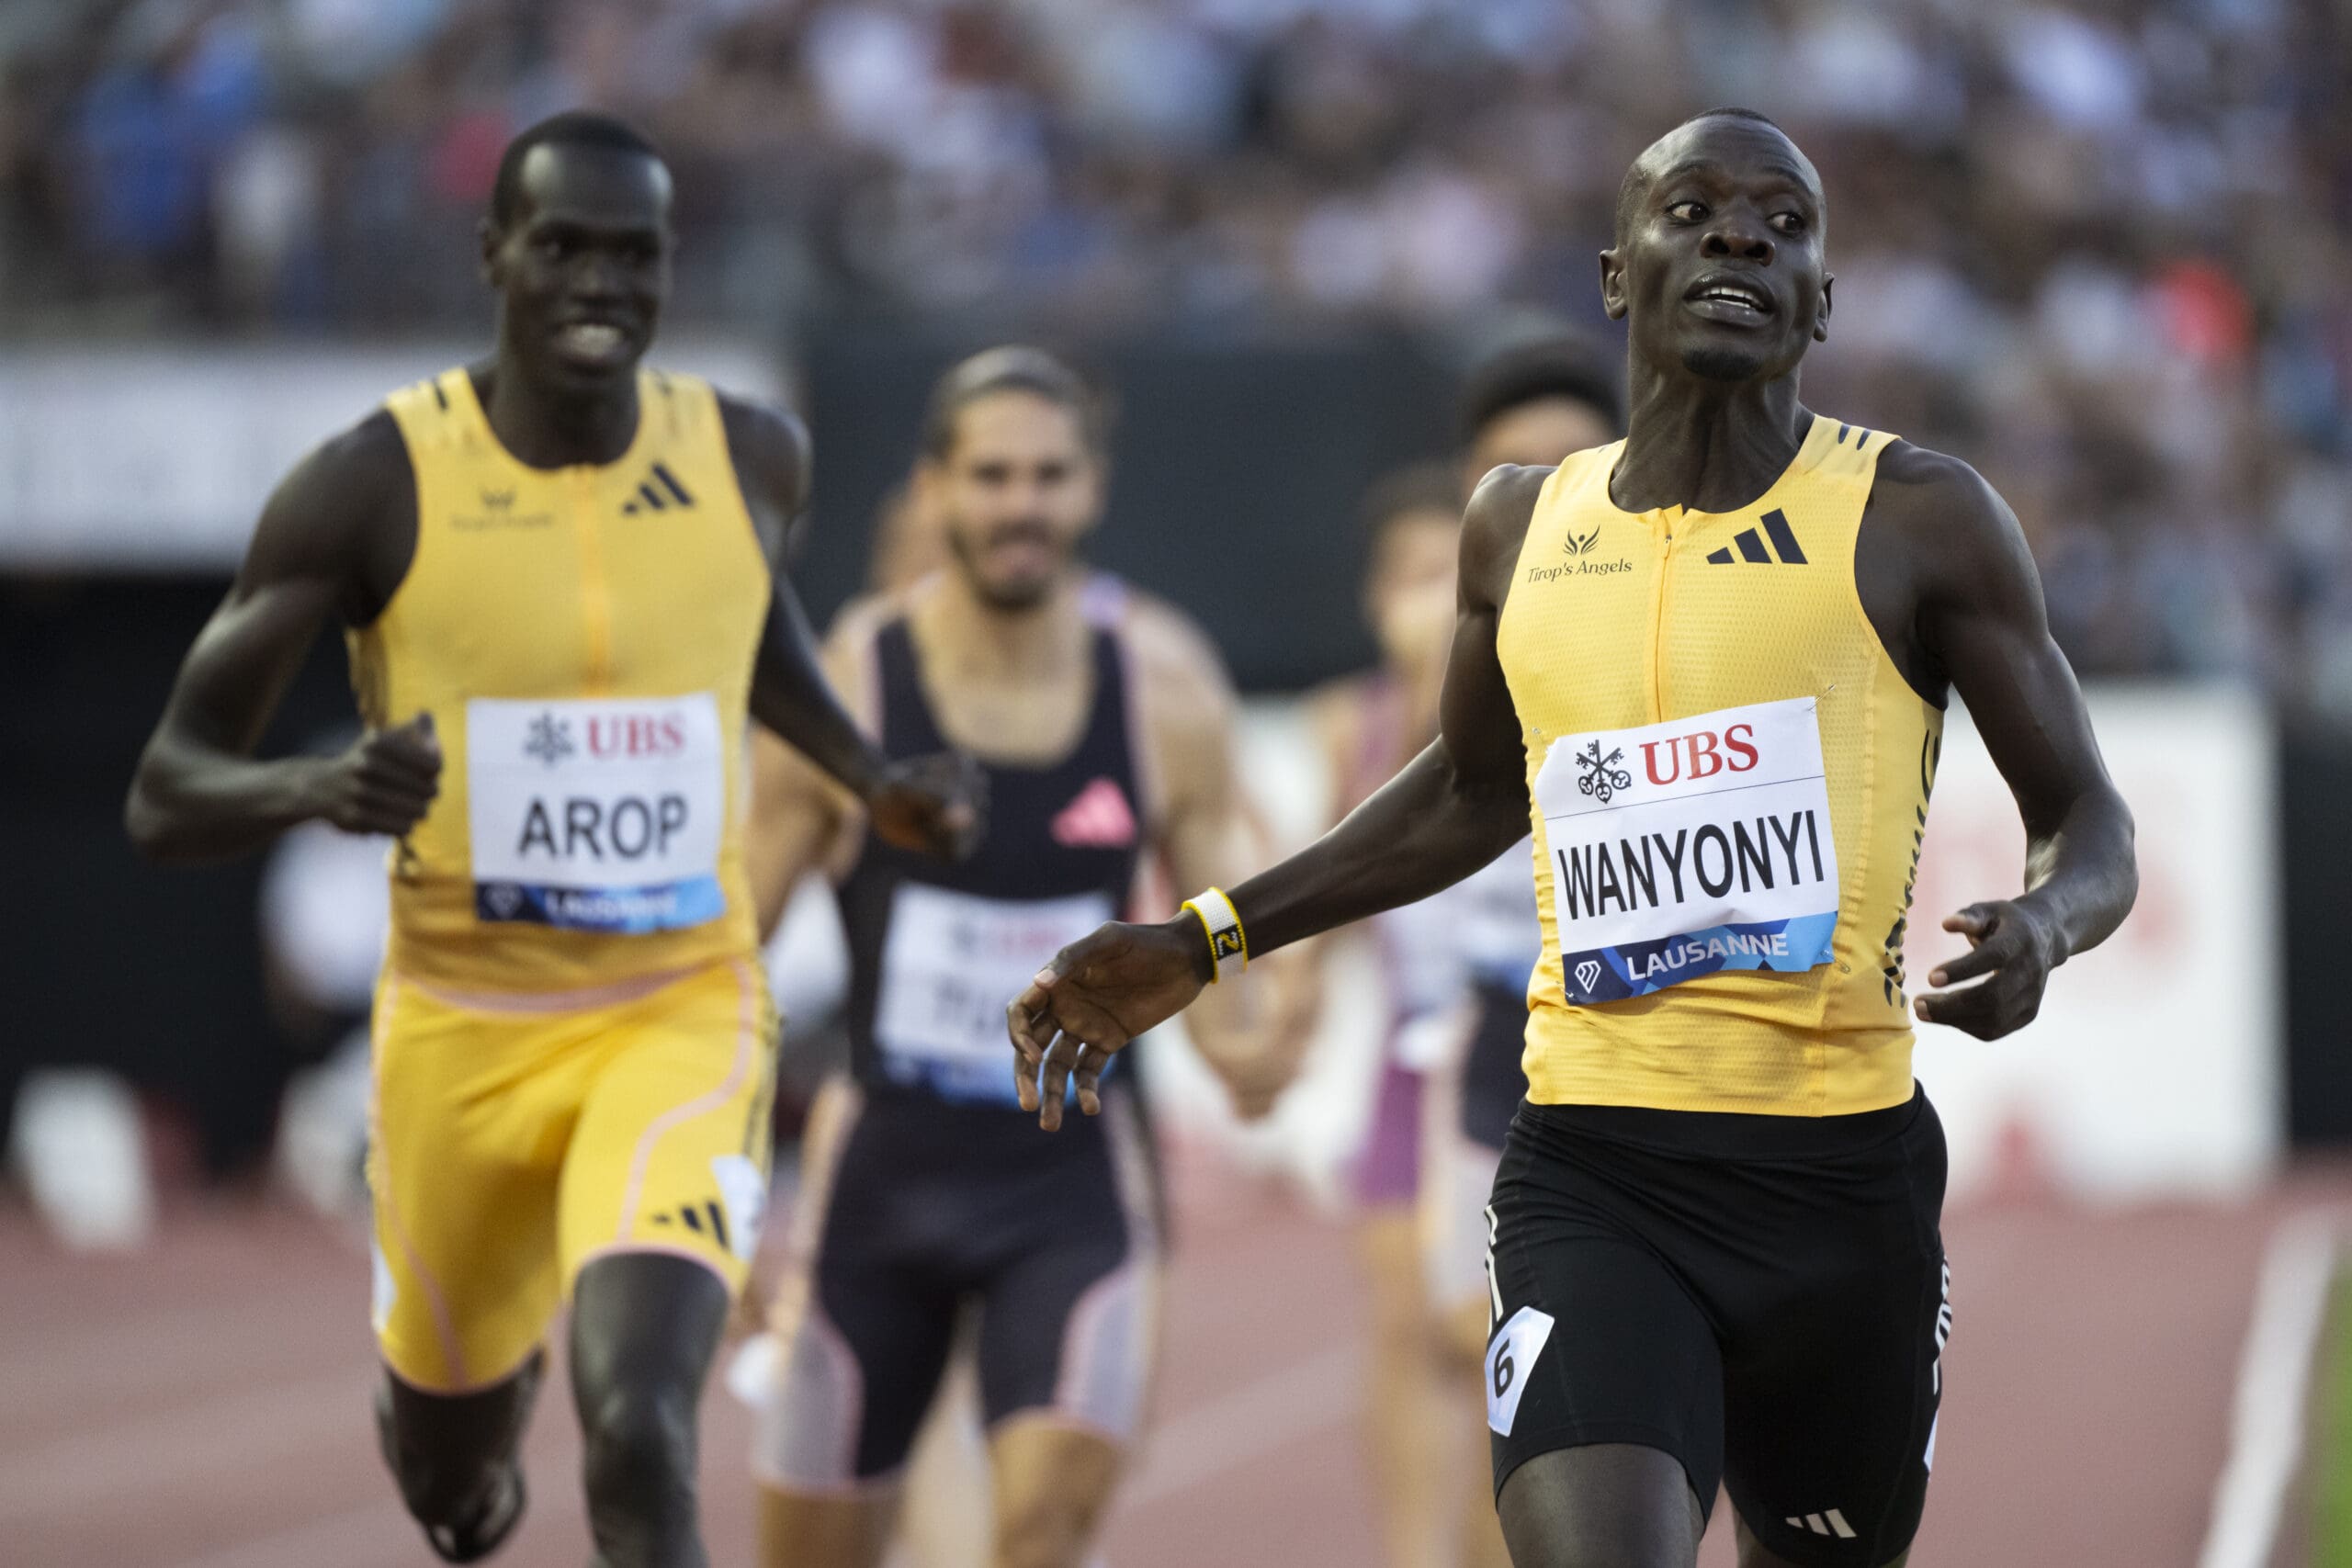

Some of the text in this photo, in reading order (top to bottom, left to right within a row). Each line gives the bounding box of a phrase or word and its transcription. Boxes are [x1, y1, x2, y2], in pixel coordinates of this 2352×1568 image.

[1528, 558, 1633, 582] Tirop's Angels
[587, 715, 685, 760] UBS
[1639, 724, 1759, 785] UBS
[517, 795, 690, 859] AROP
[1558, 809, 1825, 919] WANYONYI
[1627, 932, 1789, 981] LAUSANNE
[1494, 1337, 1514, 1399] 6
